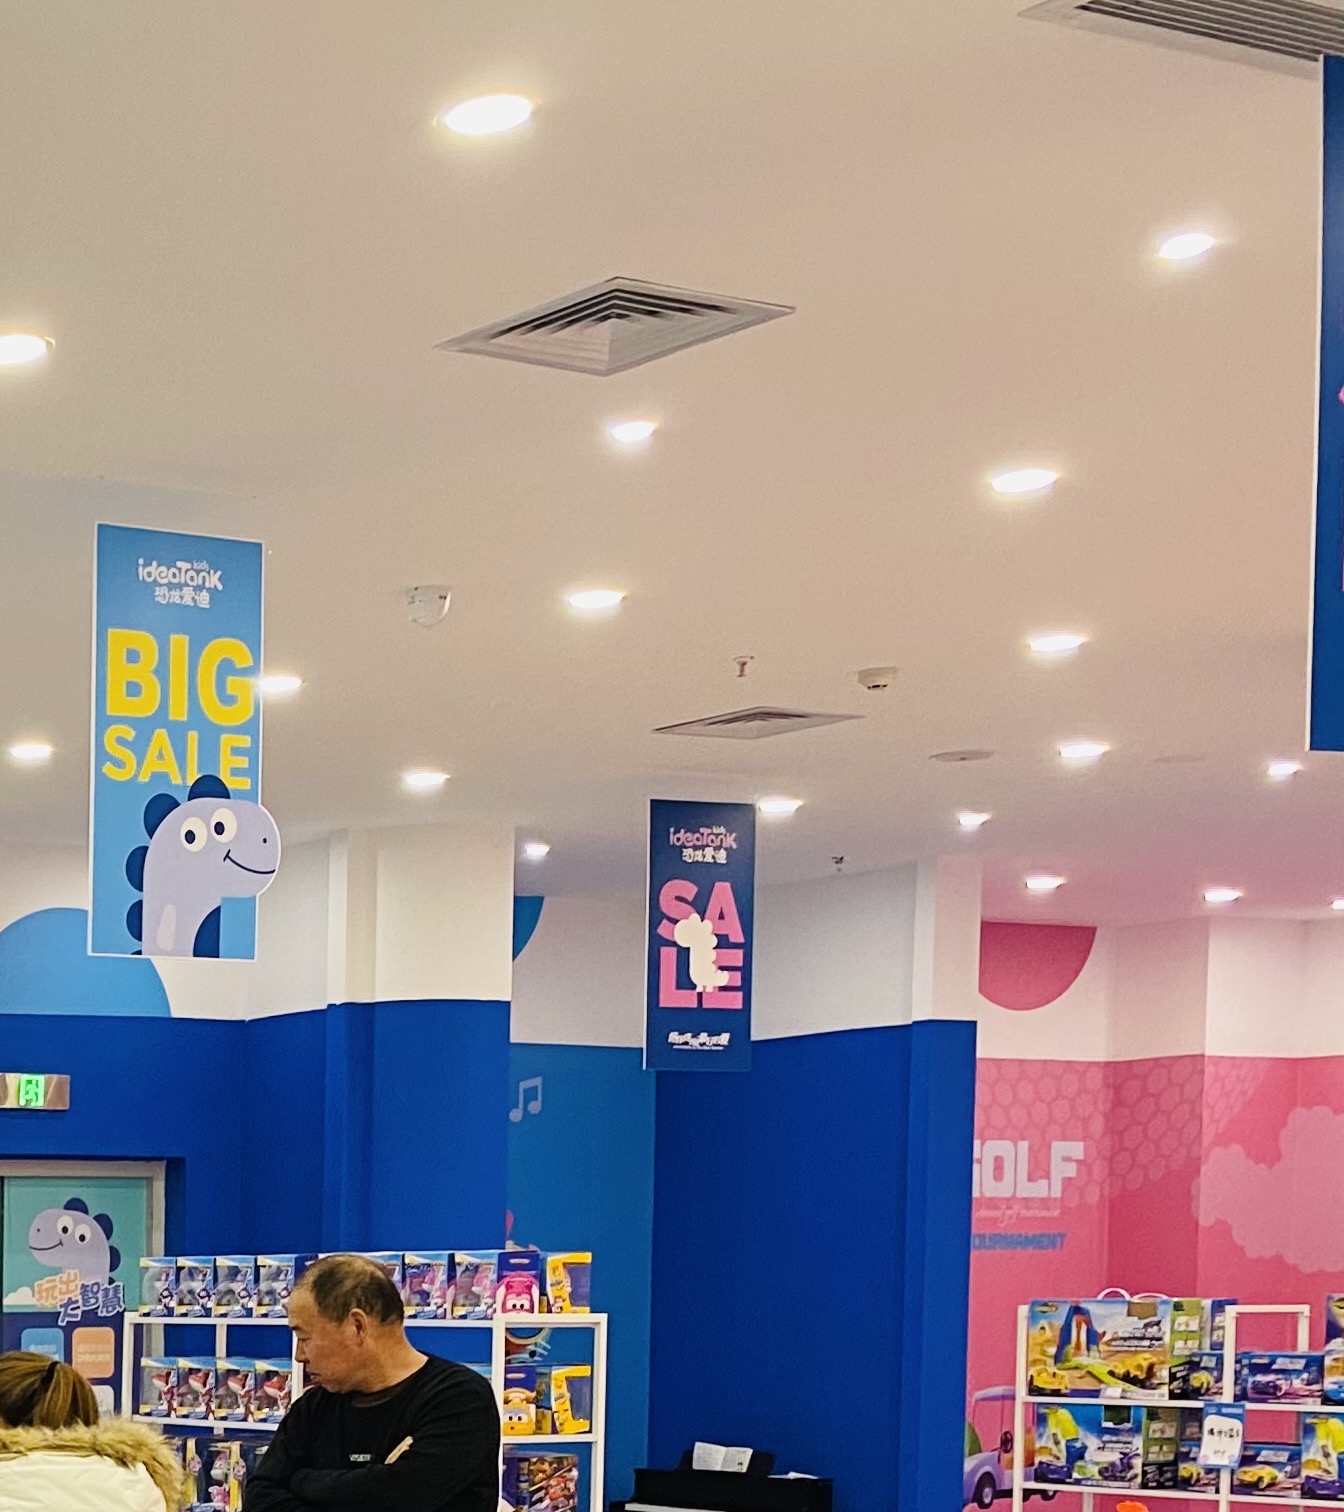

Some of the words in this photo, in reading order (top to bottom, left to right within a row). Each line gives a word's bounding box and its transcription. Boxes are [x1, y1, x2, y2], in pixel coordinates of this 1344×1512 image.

[106, 628, 255, 726] BIG
[102, 724, 252, 790] SALE
[972, 1139, 1084, 1198] OLF
[35, 1269, 80, 1303] 玩出
